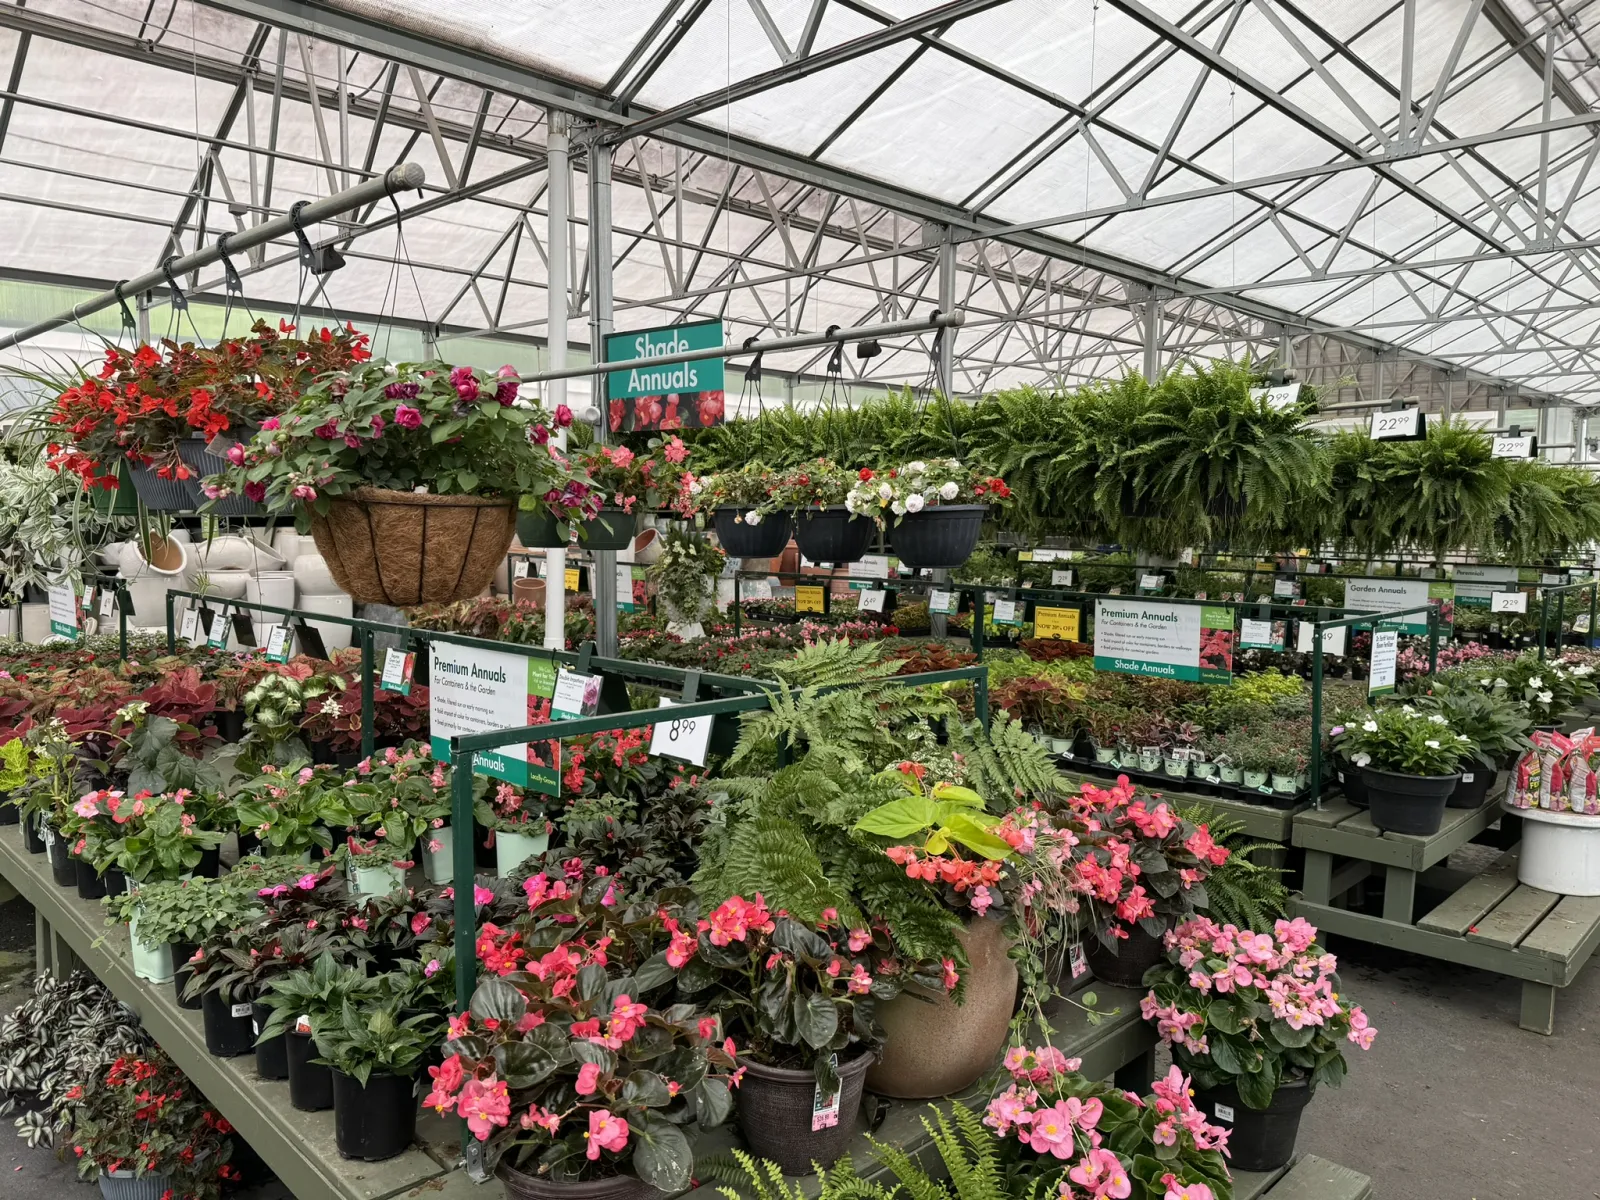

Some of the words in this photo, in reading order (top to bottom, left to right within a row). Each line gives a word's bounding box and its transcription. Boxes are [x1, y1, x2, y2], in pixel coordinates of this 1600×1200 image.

[635, 329, 689, 360] Shade
[627, 362, 698, 392] Annuals
[1456, 569, 1485, 577] Perennials
[1350, 584, 1377, 593] Garden
[1378, 585, 1407, 595] Annuals
[1101, 607, 1139, 620] Premium
[1141, 610, 1178, 623] Annuals
[1109, 619, 1134, 628] Containers
[1148, 622, 1167, 630] Garden
[434, 656, 469, 676] Premium
[471, 662, 507, 684] Annuals
[1114, 659, 1140, 670] Shade
[1141, 662, 1175, 675] Annuals
[441, 676, 464, 690] Containers
[465, 681, 469, 691] &
[477, 683, 496, 696] Garden
[473, 753, 505, 773] Annuals
[530, 772, 557, 786] Locally-Grown
